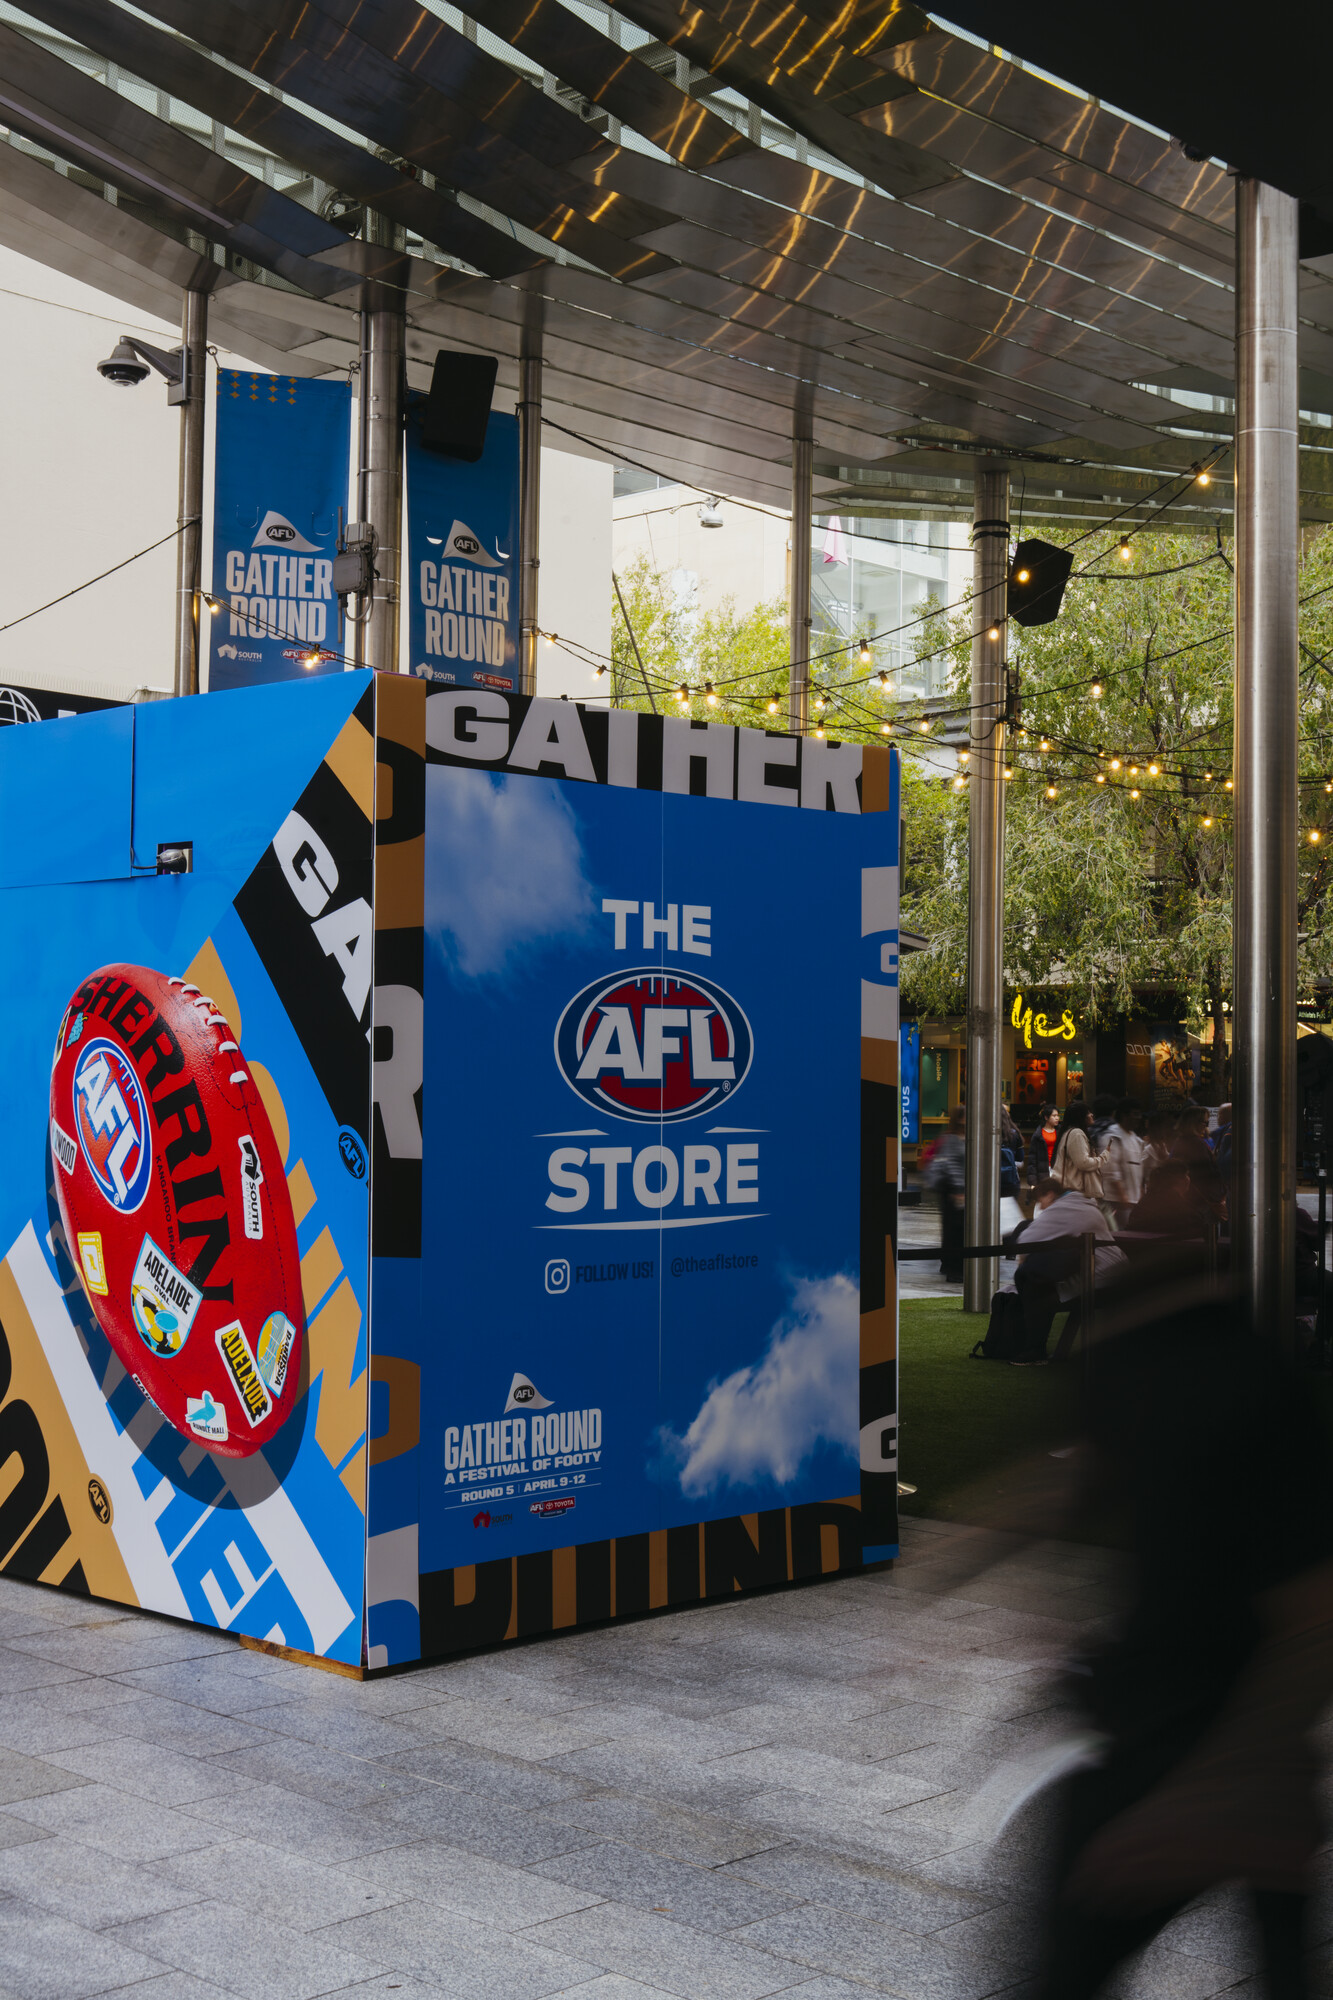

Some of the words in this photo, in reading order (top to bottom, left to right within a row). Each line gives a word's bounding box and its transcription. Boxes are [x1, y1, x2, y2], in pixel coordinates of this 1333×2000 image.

[268, 528, 294, 539] AFL
[456, 539, 478, 553] AFL
[226, 550, 333, 600] GATHER
[420, 560, 510, 622] GATHER
[229, 594, 327, 642] ROUND
[425, 608, 506, 667] ROUND
[238, 652, 262, 660] SOUTH
[434, 671, 456, 681] SOUTH
[494, 678, 512, 687] TOYOTA
[426, 690, 862, 815] GATHER
[602, 898, 712, 957] THE
[576, 1006, 736, 1080] AFL
[936, 1053, 944, 1081] Mobile
[76, 1052, 141, 1205] AFL
[902, 1085, 910, 1138] OPTUS
[71, 977, 235, 1305] SHERRIN
[339, 1139, 362, 1178] AFL
[155, 1155, 172, 1223] KANGAROO
[545, 1143, 760, 1213] STORE
[249, 1181, 260, 1232] SOUTH
[143, 1250, 193, 1315] ADELAIDE
[576, 1263, 629, 1284] FOLLOW
[632, 1261, 654, 1280] US!
[671, 1254, 758, 1278] @theaflstore
[154, 1284, 170, 1305] OVAL
[221, 1327, 268, 1423] ADELAIDE
[515, 1389, 533, 1400] AFL
[444, 1418, 526, 1471] GATHER
[531, 1408, 602, 1458] ROUND
[444, 1472, 455, 1485] A
[459, 1461, 529, 1483] FESTIVAL
[532, 1458, 551, 1472] OF
[554, 1451, 602, 1469] FOOTY
[461, 1487, 503, 1502] ROUND
[506, 1485, 514, 1495] 5
[523, 1478, 558, 1493] APRIL
[560, 1474, 586, 1487] 9-12
[89, 1486, 107, 1522] AFL
[491, 1513, 513, 1524] SOUTH
[530, 1503, 543, 1512] AFL
[554, 1499, 574, 1508] TOYOTA
